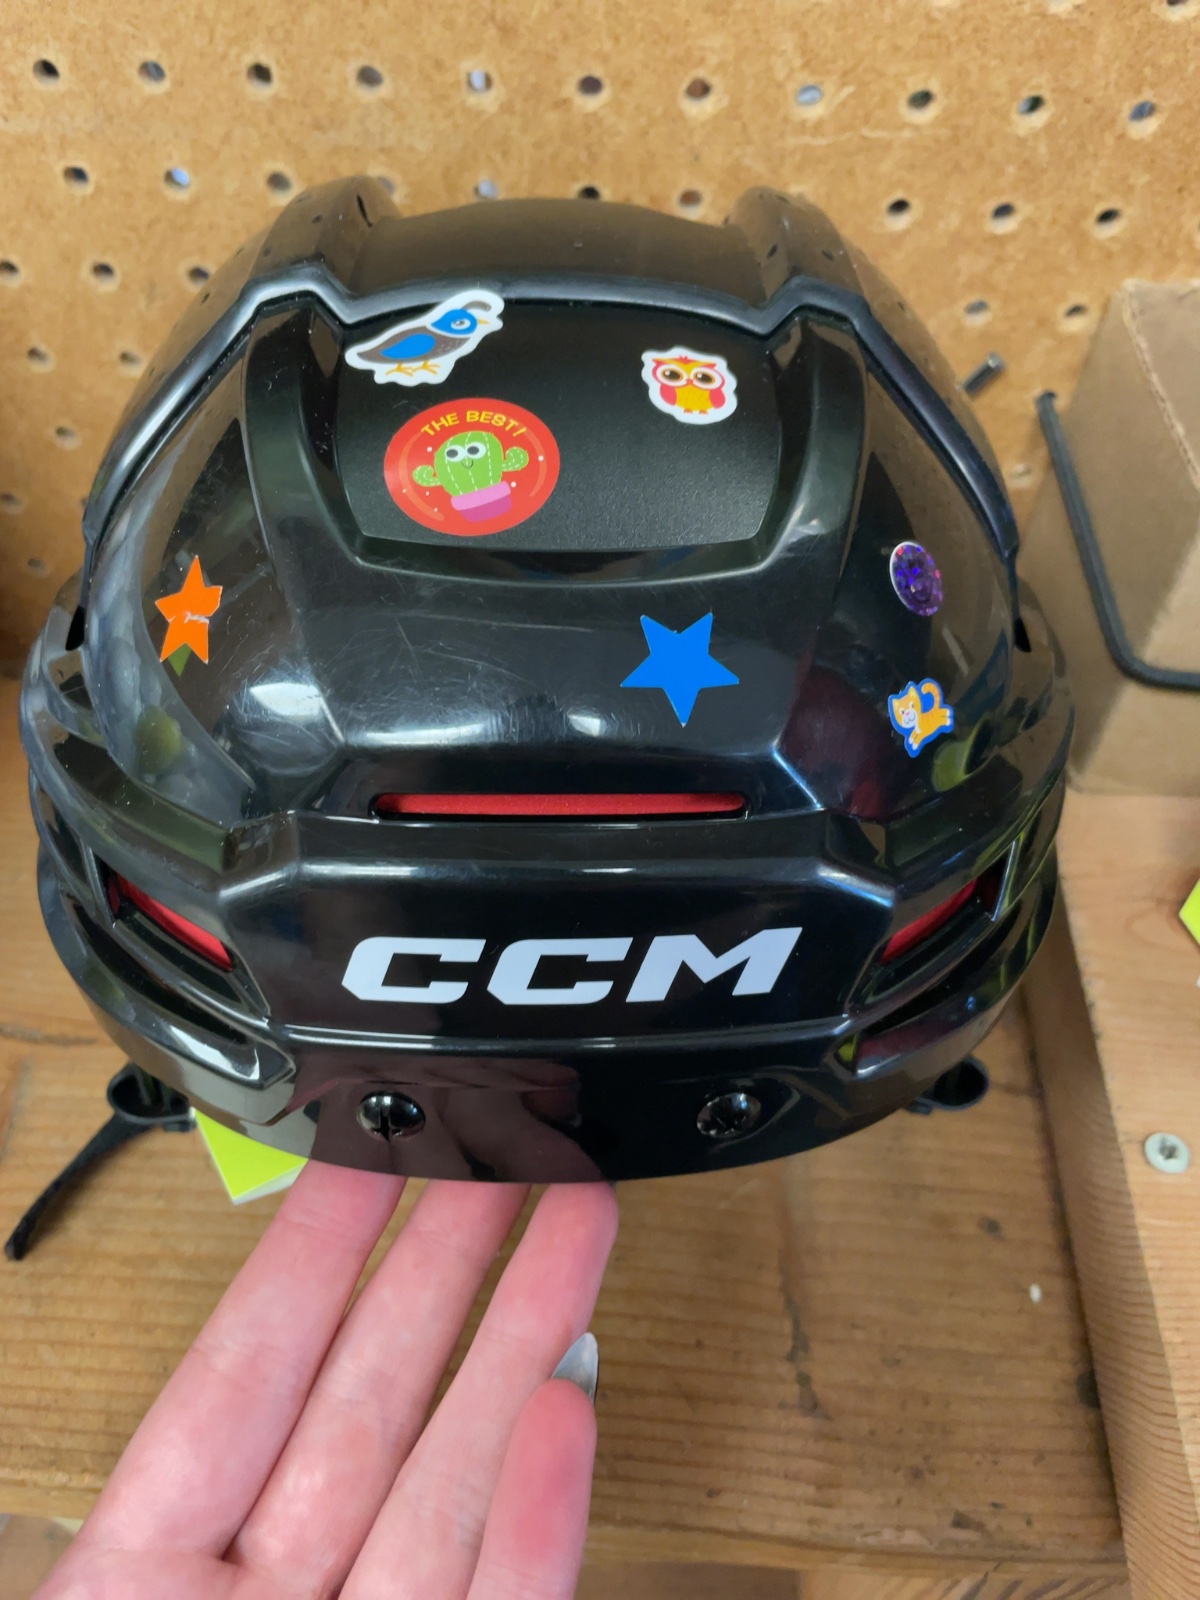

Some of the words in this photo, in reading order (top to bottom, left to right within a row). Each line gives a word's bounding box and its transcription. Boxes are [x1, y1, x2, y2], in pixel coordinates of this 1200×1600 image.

[421, 412, 460, 437] THE
[466, 410, 527, 437] BEST!
[341, 926, 802, 1005] CCM
